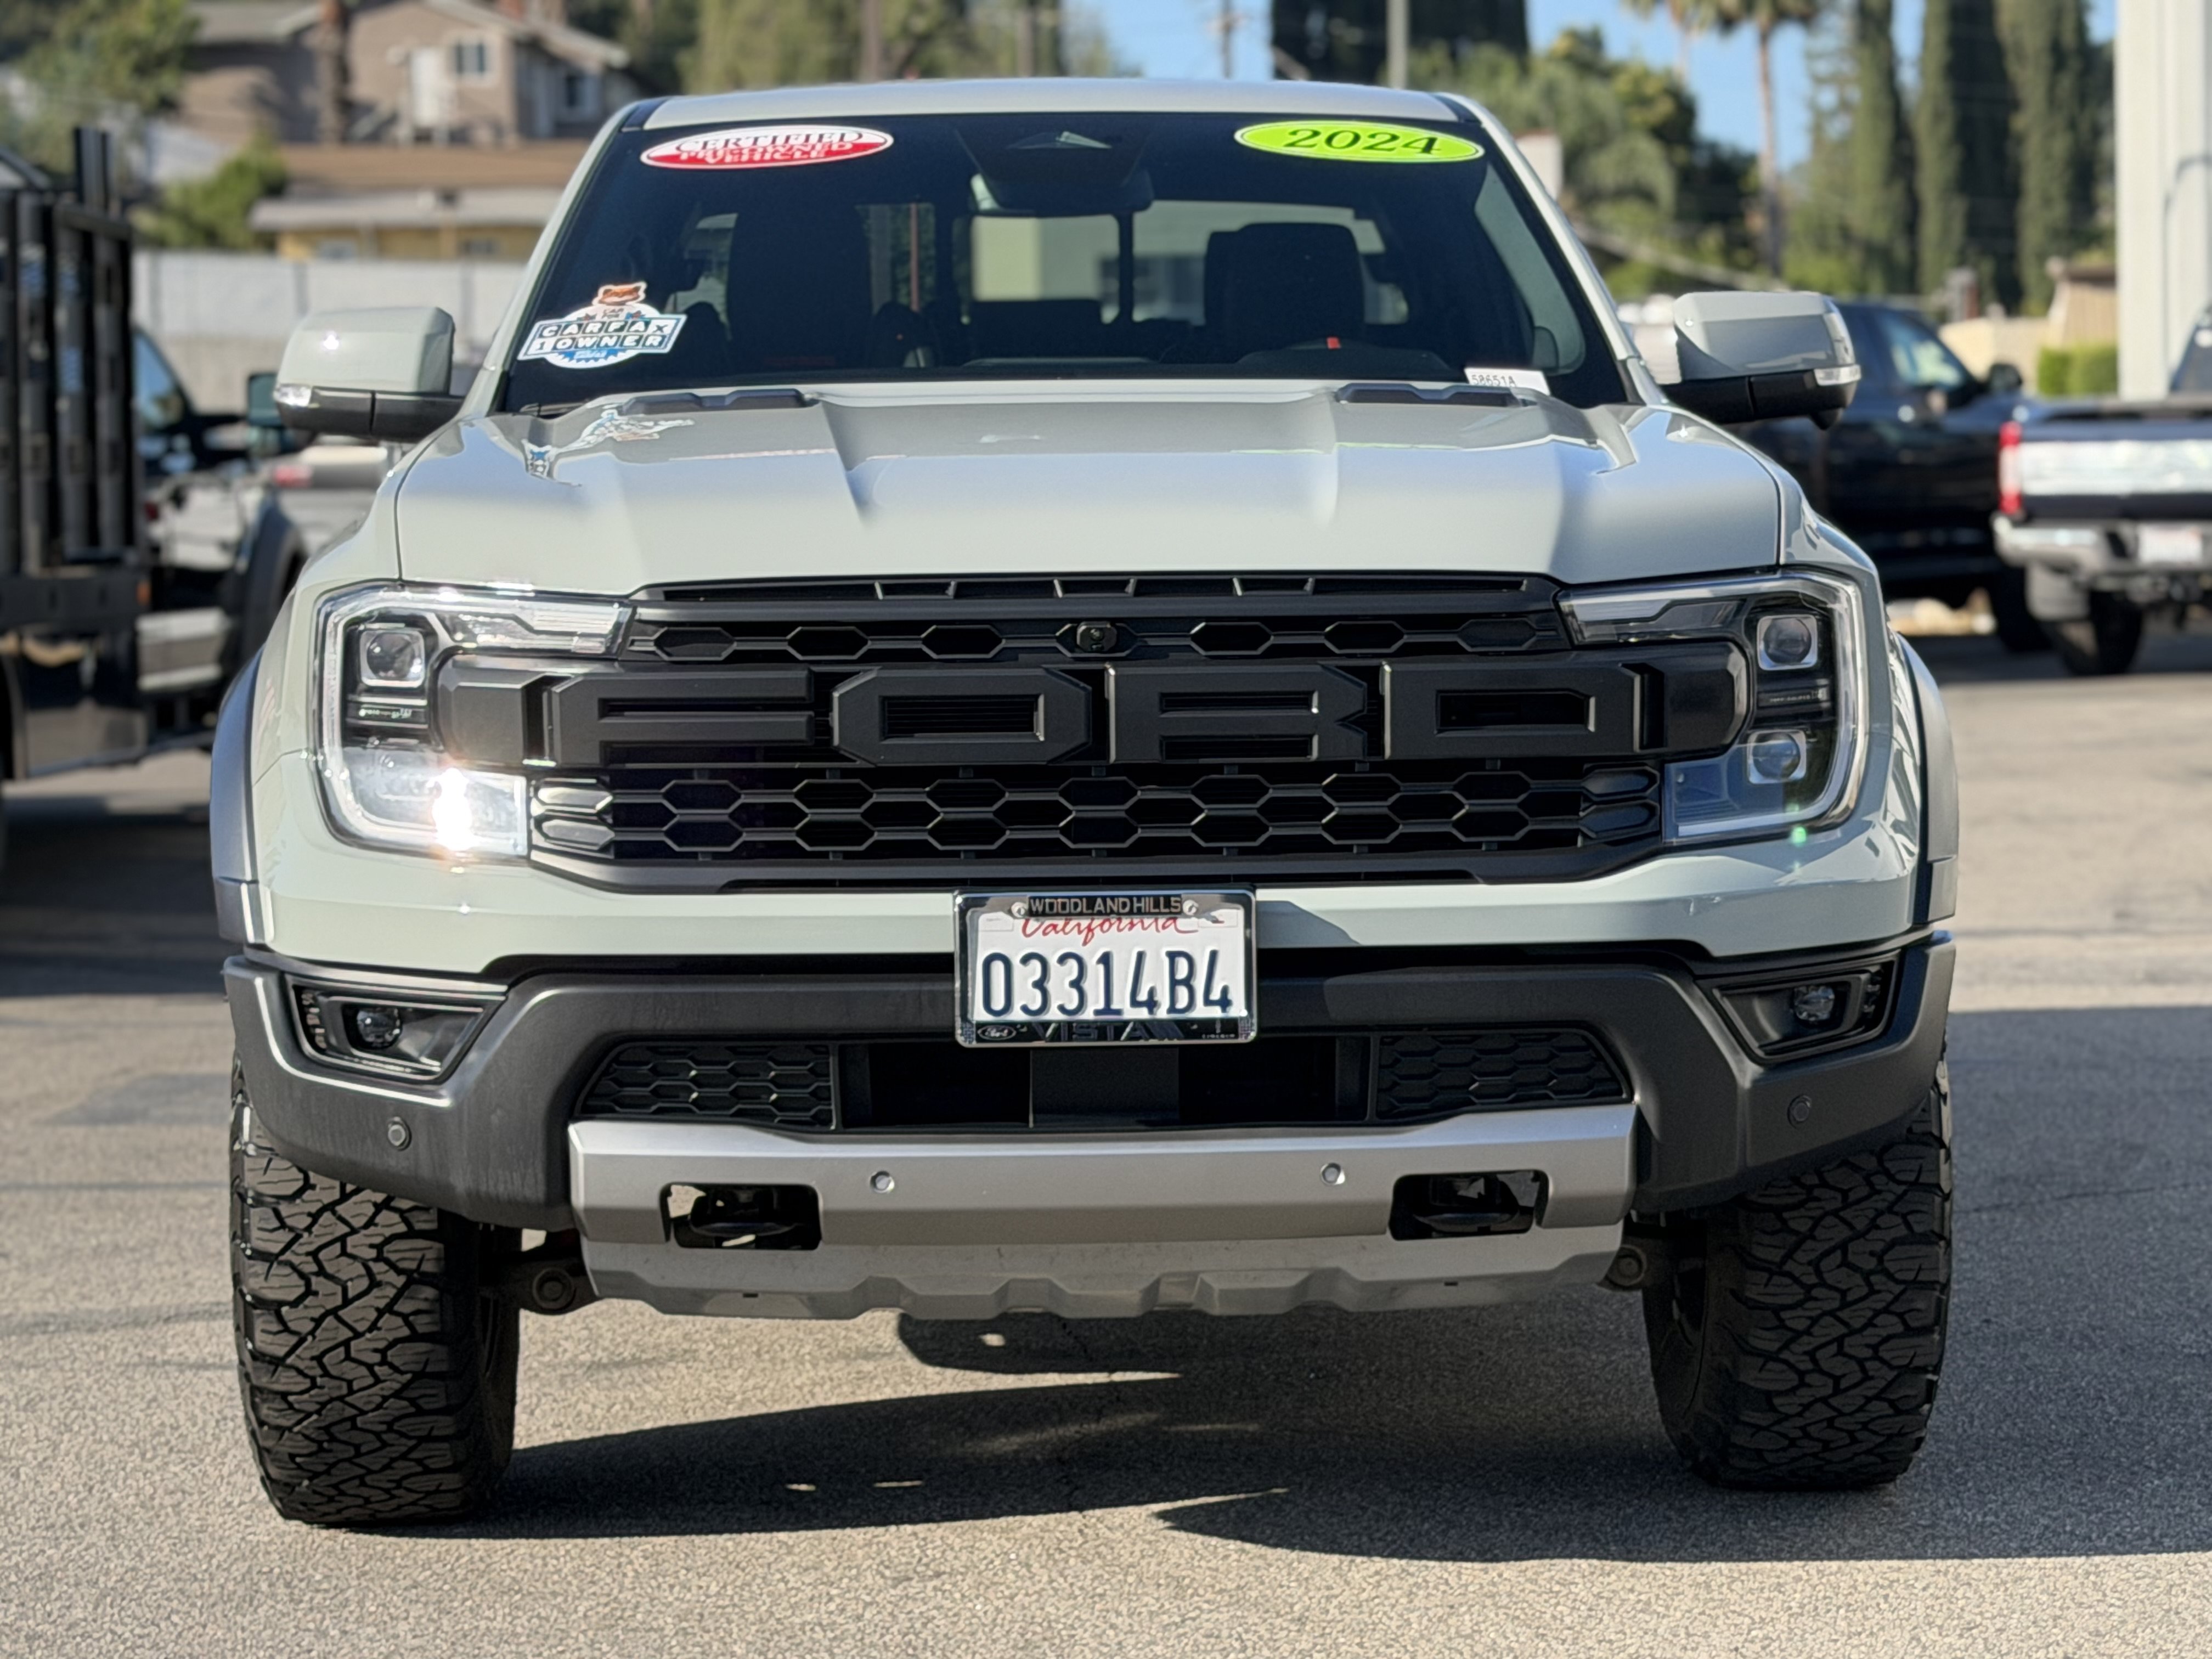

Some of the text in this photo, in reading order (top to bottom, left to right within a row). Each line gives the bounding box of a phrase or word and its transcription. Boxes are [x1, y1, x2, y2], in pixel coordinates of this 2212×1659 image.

[676, 132, 863, 152] CERTIFIED
[1283, 128, 1442, 155] 2024
[704, 147, 826, 164] VEHICLE
[541, 321, 668, 337] CARFAX
[535, 336, 662, 351] 1 OWNER
[550, 662, 1640, 768] FORD
[1030, 896, 1181, 915] WOODLAND HILLS
[981, 949, 1233, 1017] 03314B4
[1031, 1020, 1150, 1042] VISTA
